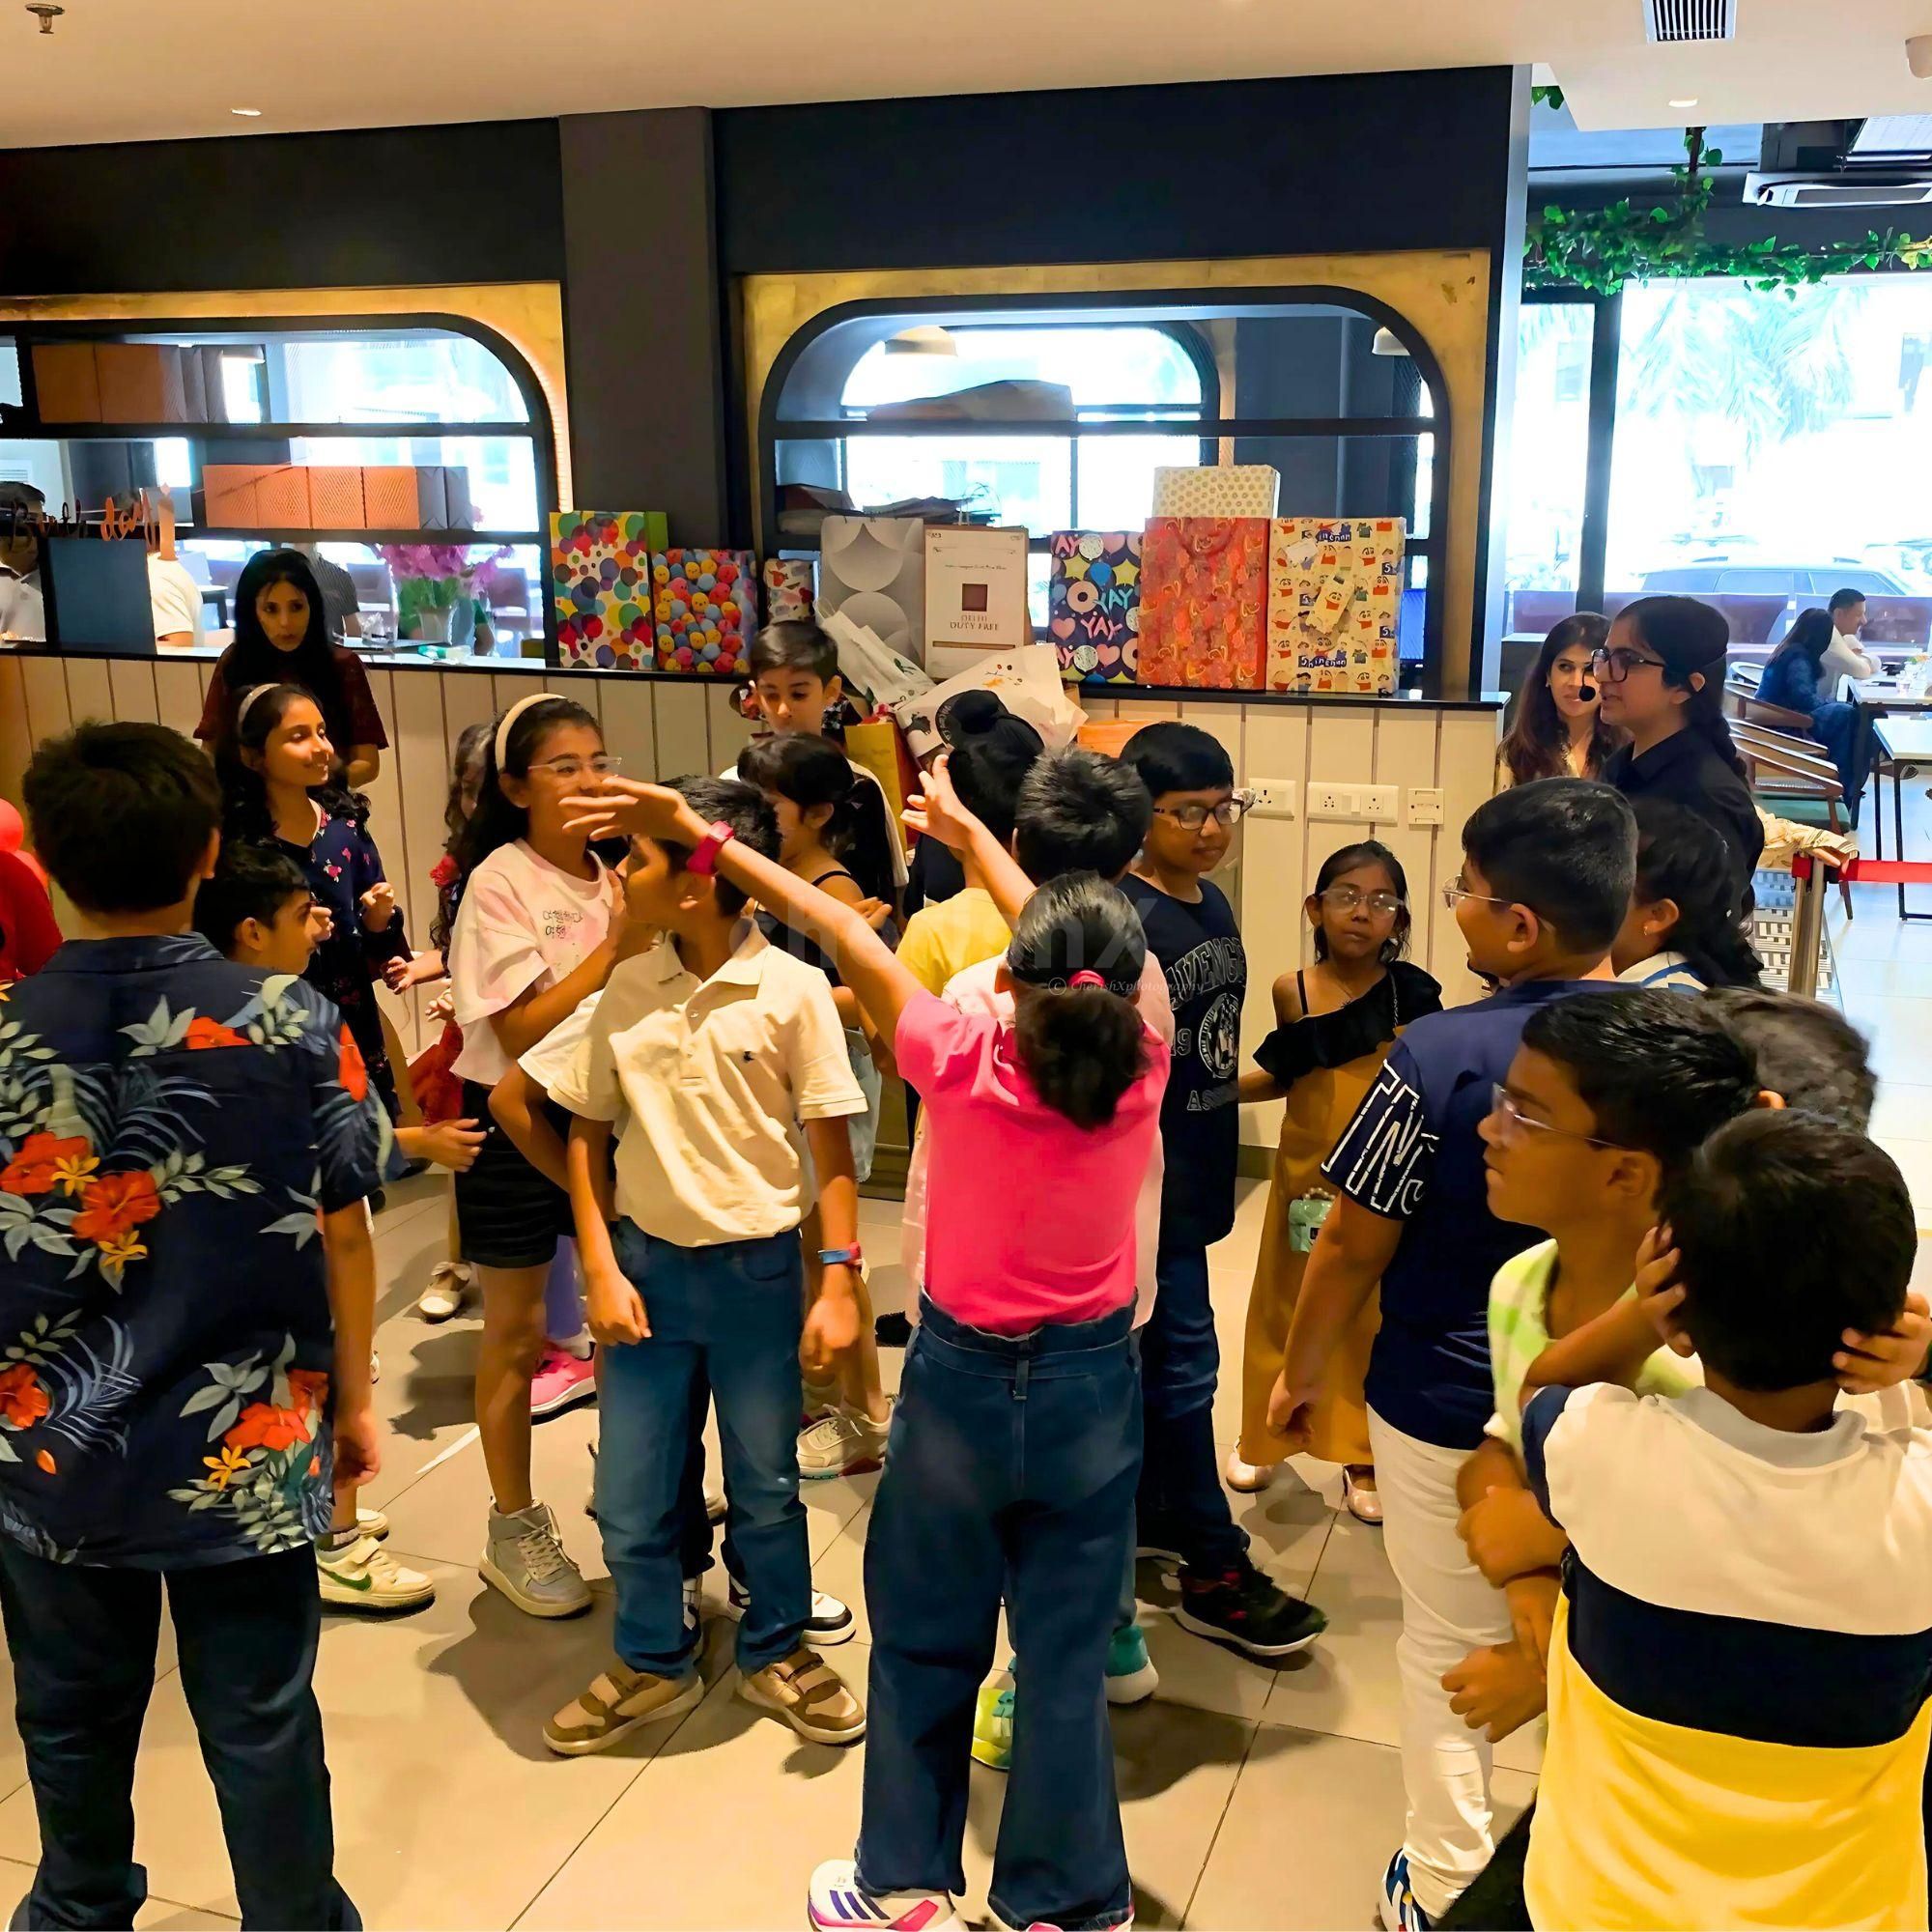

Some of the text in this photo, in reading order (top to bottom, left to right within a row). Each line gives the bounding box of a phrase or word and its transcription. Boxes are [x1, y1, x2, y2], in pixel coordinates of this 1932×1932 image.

[1093, 588, 1133, 614] YAY
[950, 621, 975, 630] DUTY
[1080, 616, 1123, 640] YAY
